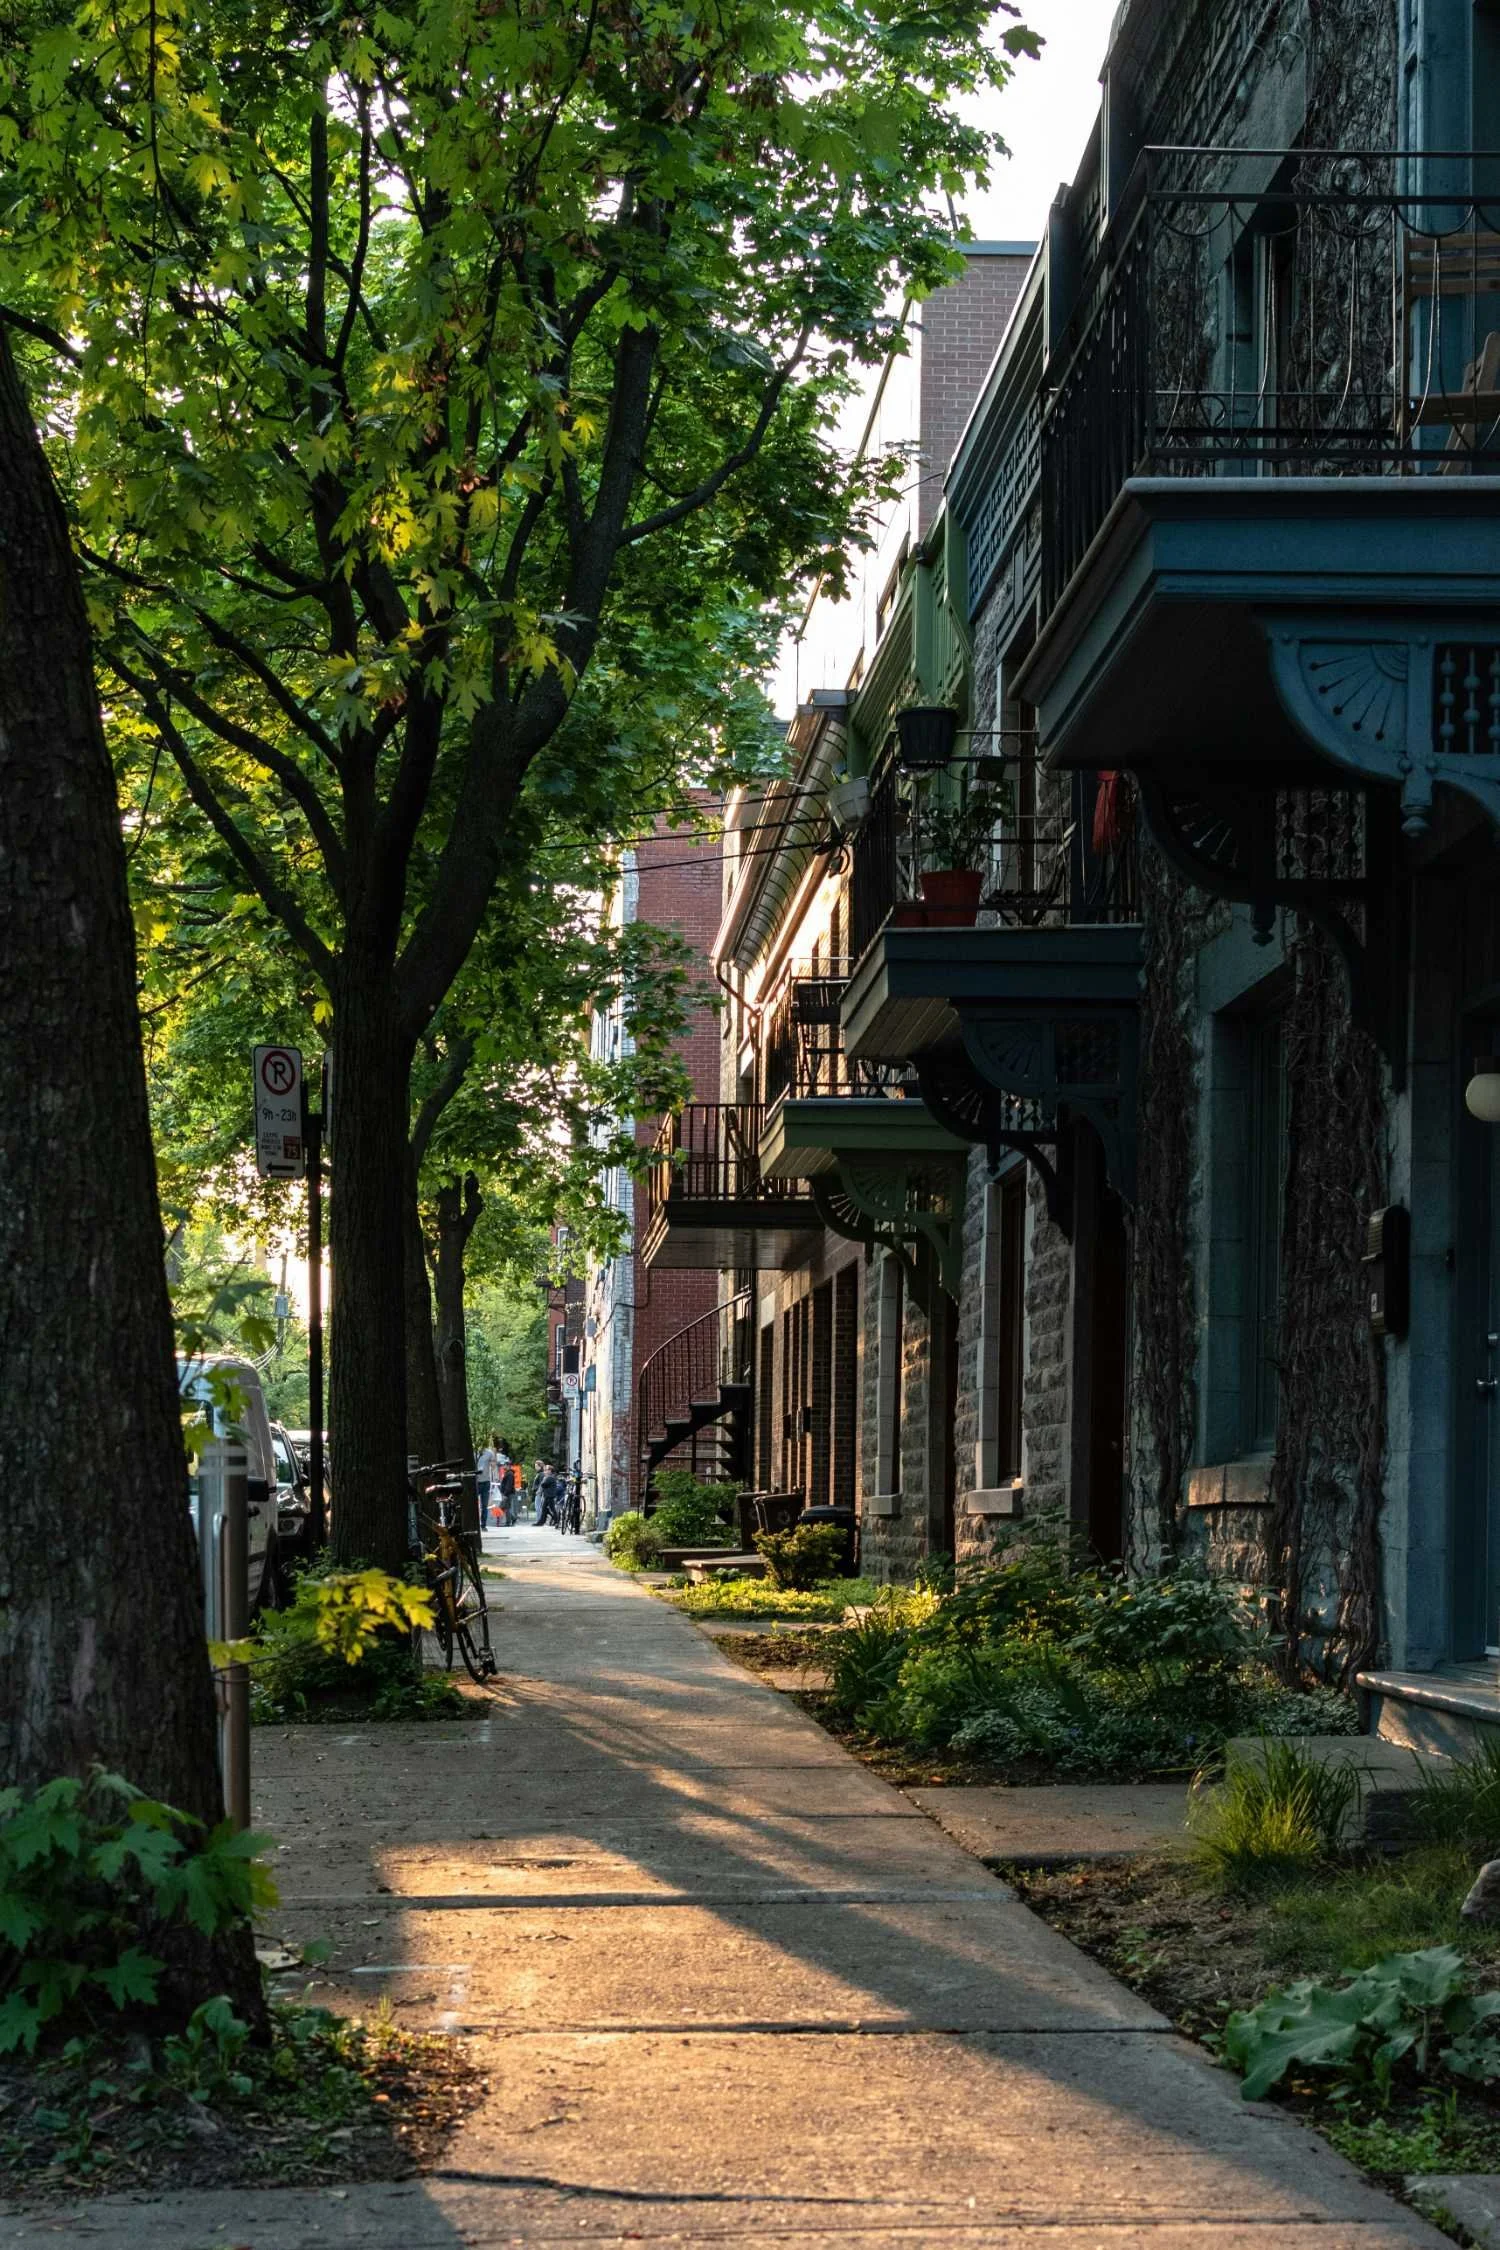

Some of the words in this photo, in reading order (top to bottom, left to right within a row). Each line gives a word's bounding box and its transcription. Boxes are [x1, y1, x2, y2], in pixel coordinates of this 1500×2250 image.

[273, 1061, 286, 1085] P
[262, 1107, 274, 1120] 9h
[281, 1109, 297, 1121] 23h
